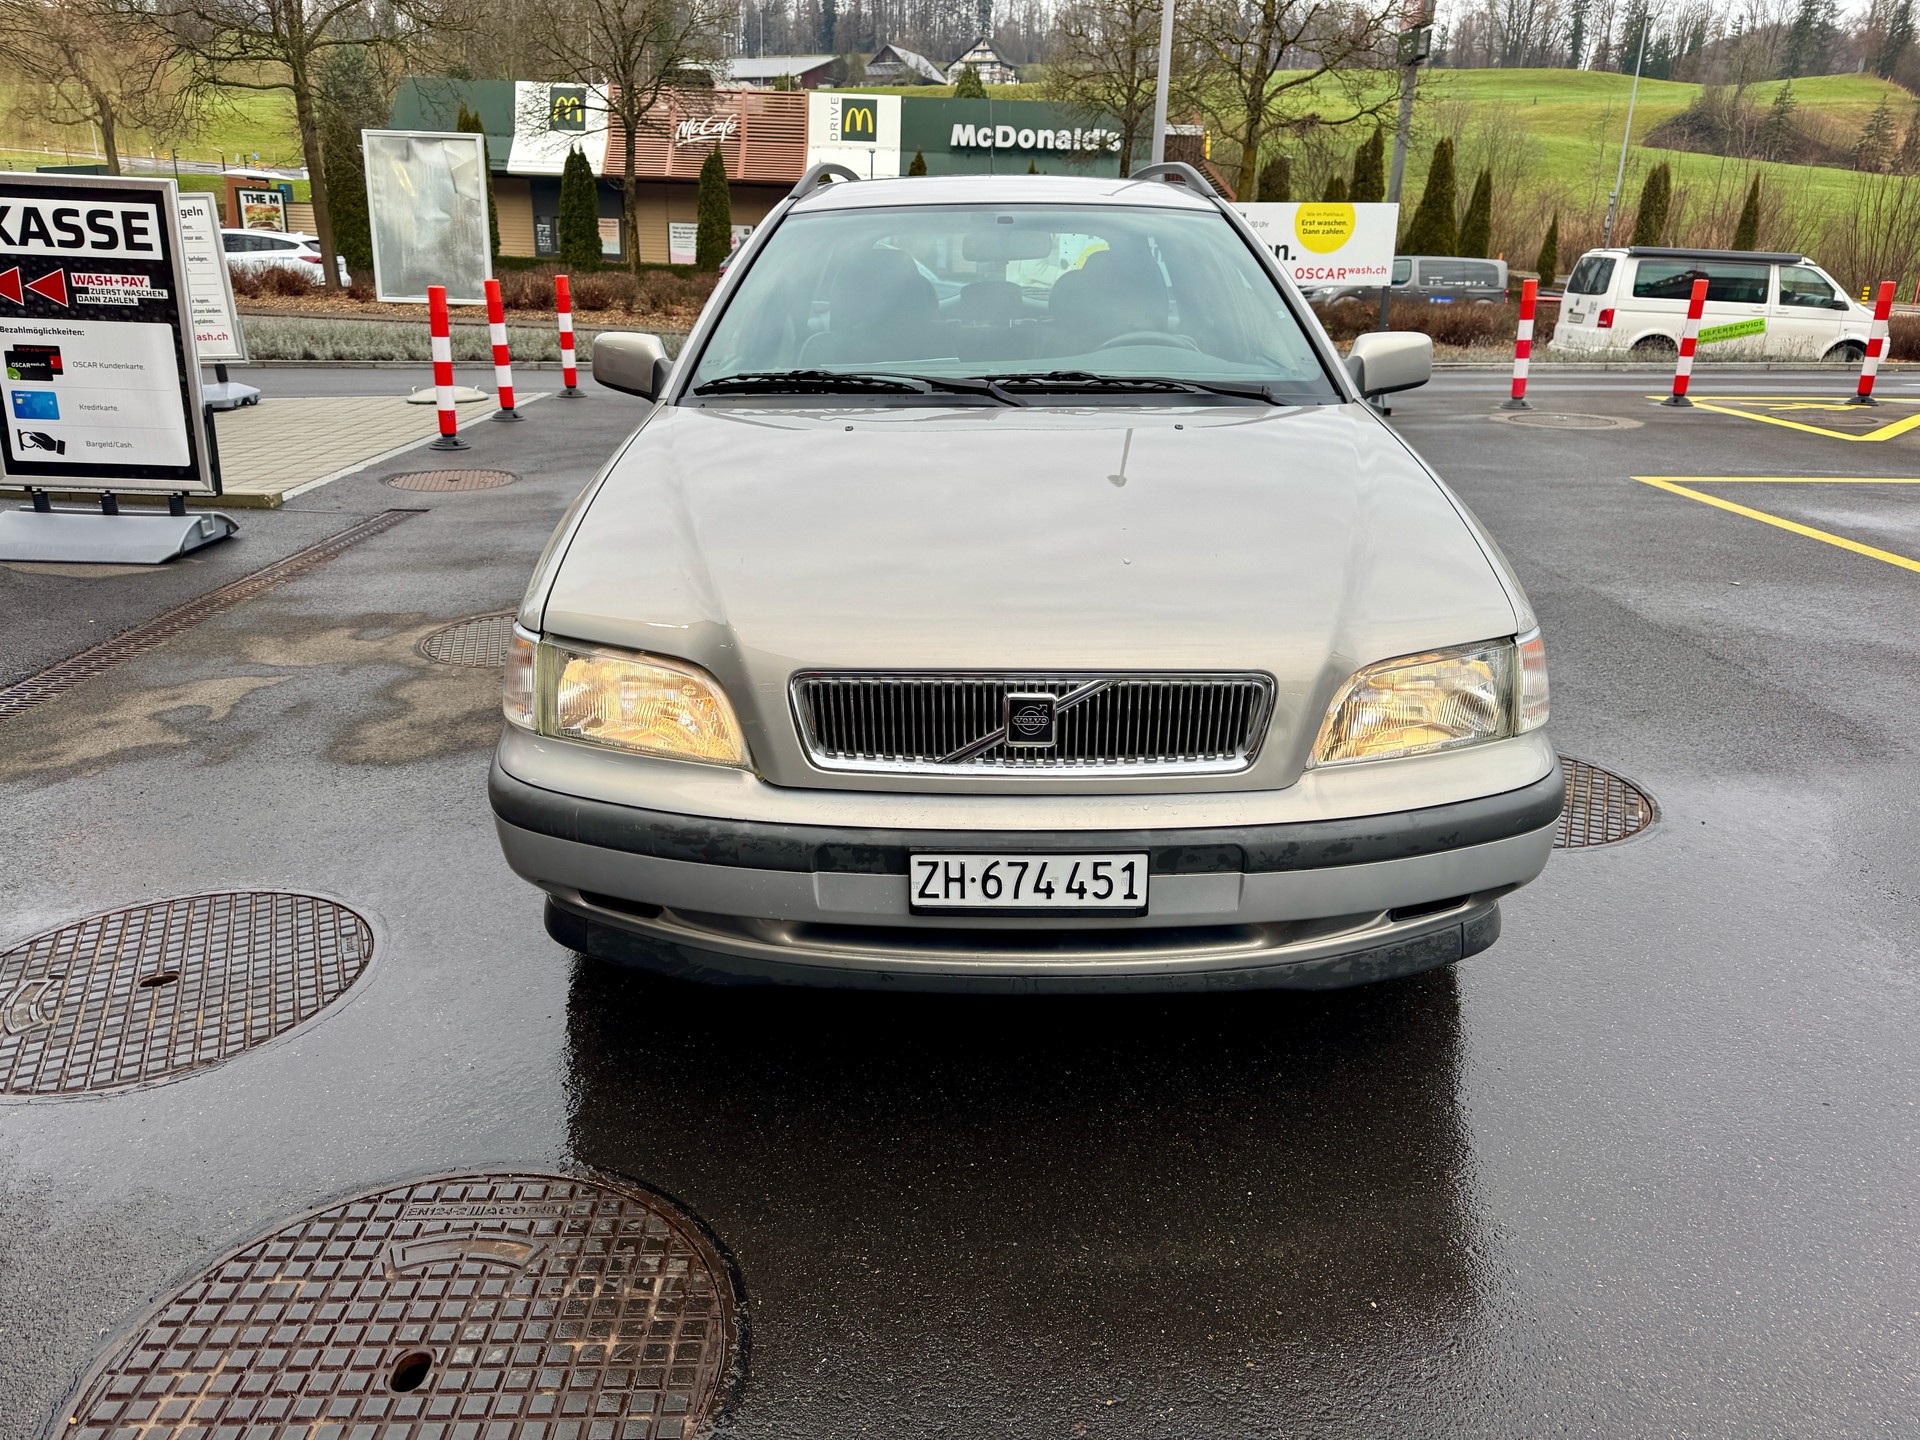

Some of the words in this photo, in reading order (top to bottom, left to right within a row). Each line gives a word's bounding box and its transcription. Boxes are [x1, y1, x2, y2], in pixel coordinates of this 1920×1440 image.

[830, 97, 839, 141] DRIVE
[675, 113, 738, 142] McCafé
[950, 124, 1122, 152] McDonald's
[243, 194, 266, 204] THE
[180, 206, 203, 219] geln
[0, 205, 154, 252] KASSE
[72, 274, 149, 288] WASH+PAY.
[89, 287, 121, 296] ZUERST
[122, 289, 167, 298] WASCHEN.
[77, 295, 101, 303] DANN
[102, 297, 138, 305] ZAHLEN.
[0, 326, 85, 336] Bezahlmöglichkeiten:
[196, 332, 229, 341] ash.ch
[99, 362, 146, 370] Kundenkarte.
[79, 403, 120, 411] Kreditkarte.
[86, 440, 134, 449] Bargeld/Cash.
